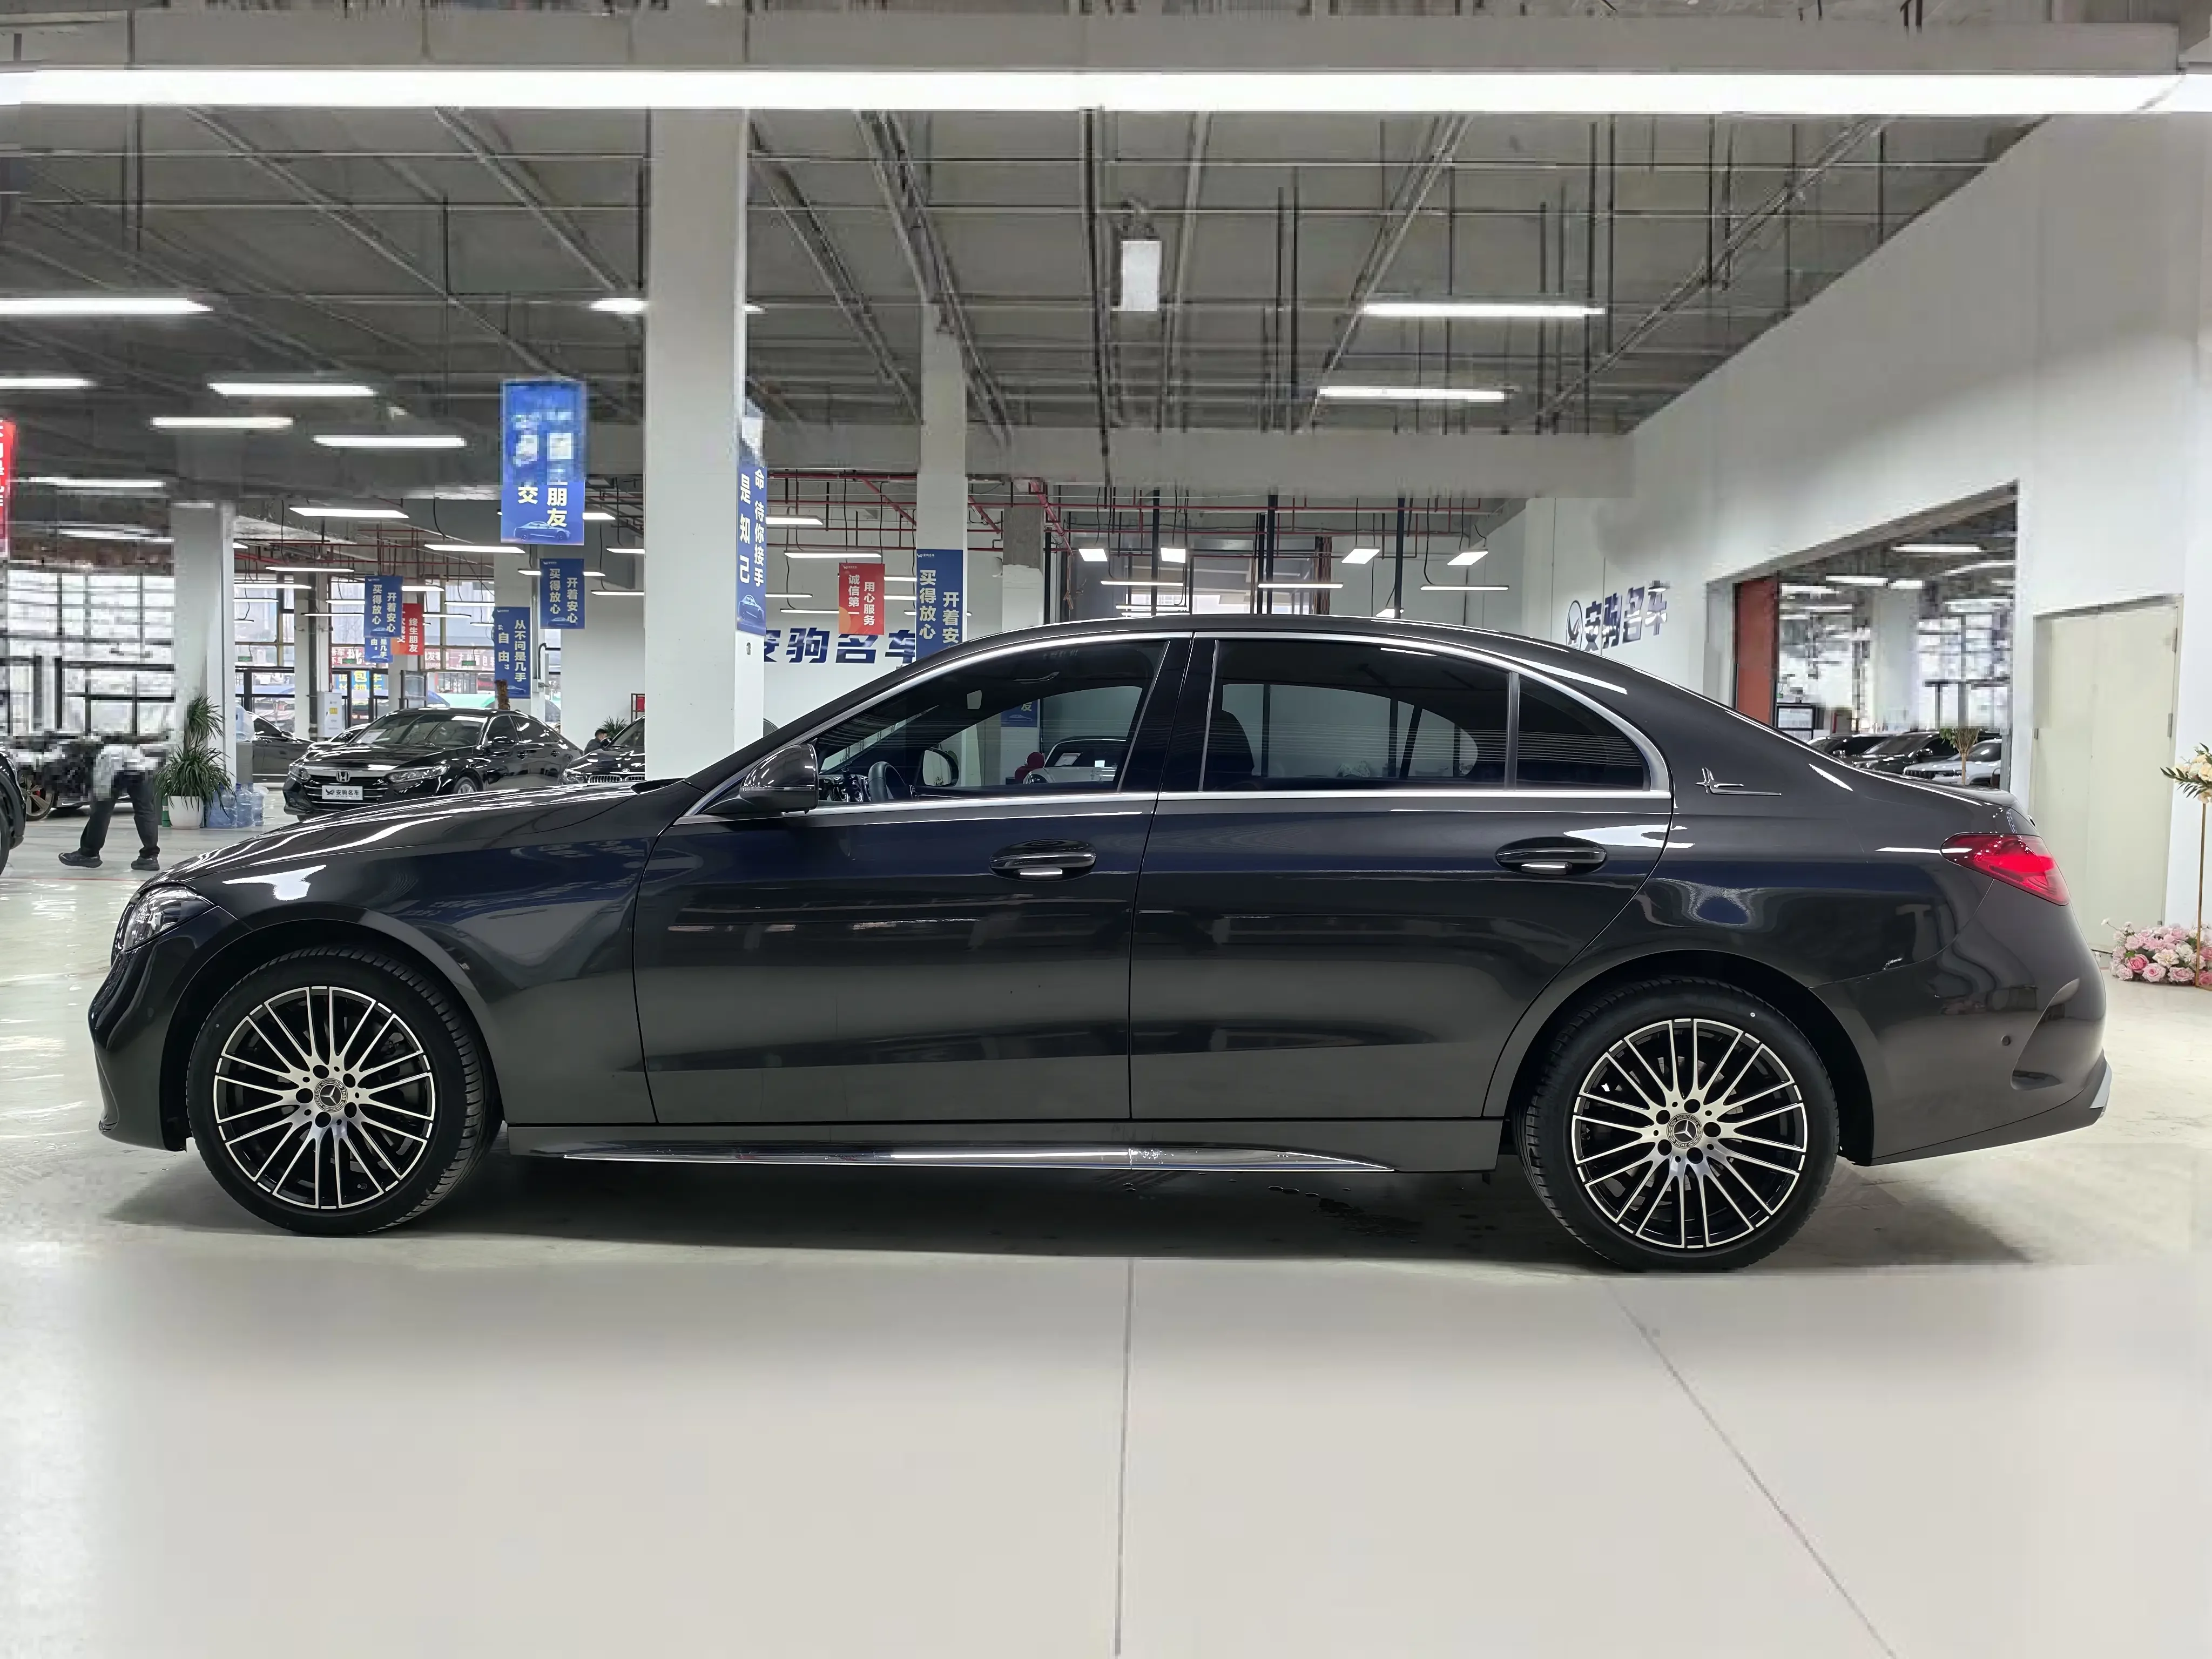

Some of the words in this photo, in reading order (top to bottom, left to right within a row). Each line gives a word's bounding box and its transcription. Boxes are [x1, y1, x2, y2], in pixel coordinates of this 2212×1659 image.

[372, 584, 383, 625] 买得放心
[386, 592, 397, 633] 开着安心
[549, 568, 561, 615] 买得放心
[567, 577, 578, 623] 开着安心
[848, 574, 860, 615] 诚信第一
[864, 582, 875, 626] 用心服务
[919, 570, 936, 640] 买得放心
[409, 618, 419, 652] 终生朋友
[942, 592, 960, 647] 开着安
[515, 620, 527, 682] 从不问是几手
[1676, 1115, 1699, 1125] MERCEDES
